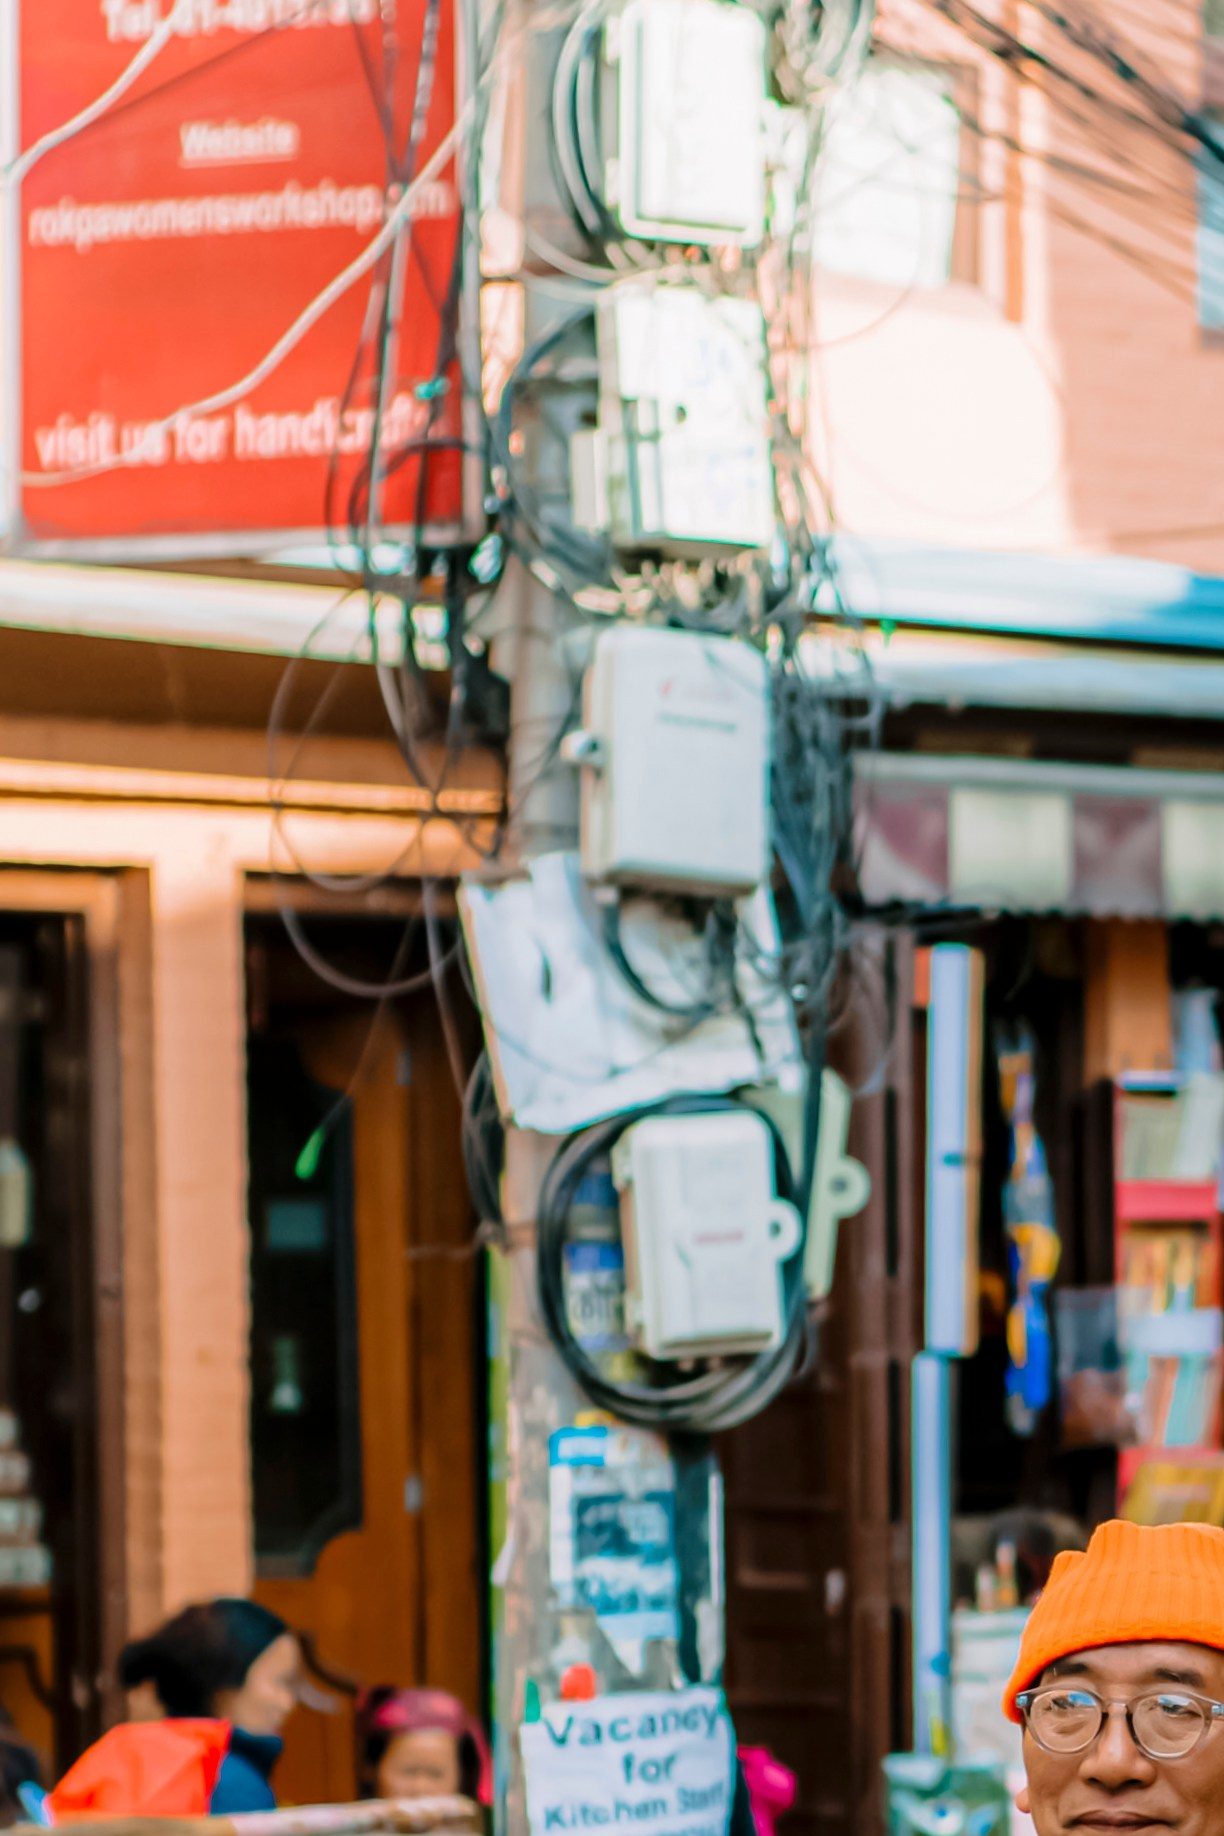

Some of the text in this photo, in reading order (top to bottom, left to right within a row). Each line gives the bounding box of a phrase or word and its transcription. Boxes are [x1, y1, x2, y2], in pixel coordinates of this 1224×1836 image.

[35, 412, 116, 470] visit
[173, 407, 230, 461] for
[544, 1704, 717, 1747] Vacancy
[622, 1752, 676, 1785] for
[544, 1798, 667, 1831] Kitchen
